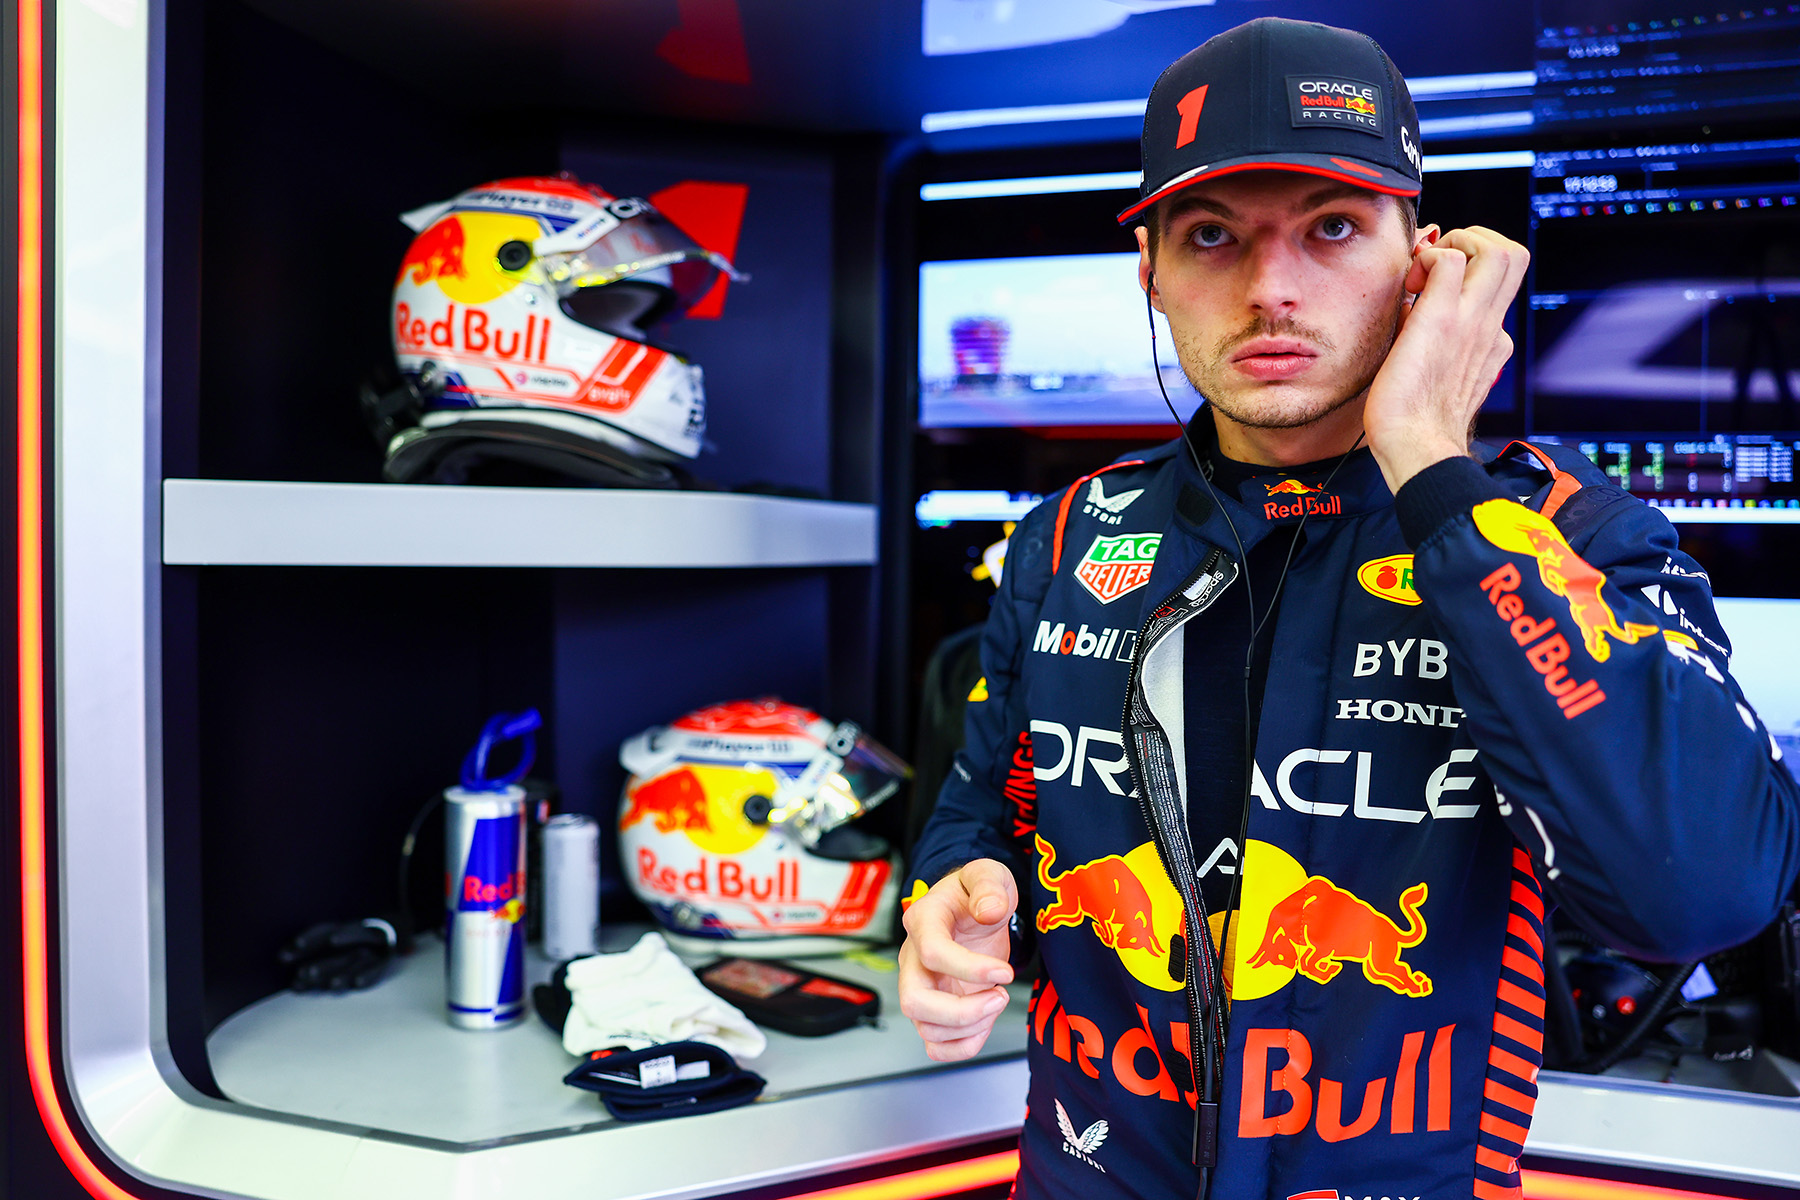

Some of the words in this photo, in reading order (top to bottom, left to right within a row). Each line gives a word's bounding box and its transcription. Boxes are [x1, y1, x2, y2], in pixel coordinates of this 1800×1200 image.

[1299, 81, 1374, 101] ORACLE
[1300, 95, 1323, 107] Red
[1324, 95, 1345, 108] Bull
[1176, 84, 1209, 150] 1
[1302, 111, 1376, 127] RACING
[397, 301, 455, 350] Red
[463, 307, 551, 363] Bull
[1263, 497, 1303, 520] Red
[1305, 495, 1342, 515] Bull
[1100, 537, 1160, 560] TAG
[1081, 562, 1153, 595] HEUER
[1188, 570, 1224, 608] sparco
[1032, 620, 1120, 660] Mobil
[1479, 561, 1557, 647] Red
[1525, 631, 1607, 720] Bull
[463, 873, 516, 903] Red
[636, 846, 708, 895] Red
[716, 860, 799, 901] Bull
[1237, 1023, 1457, 1144] Bull
